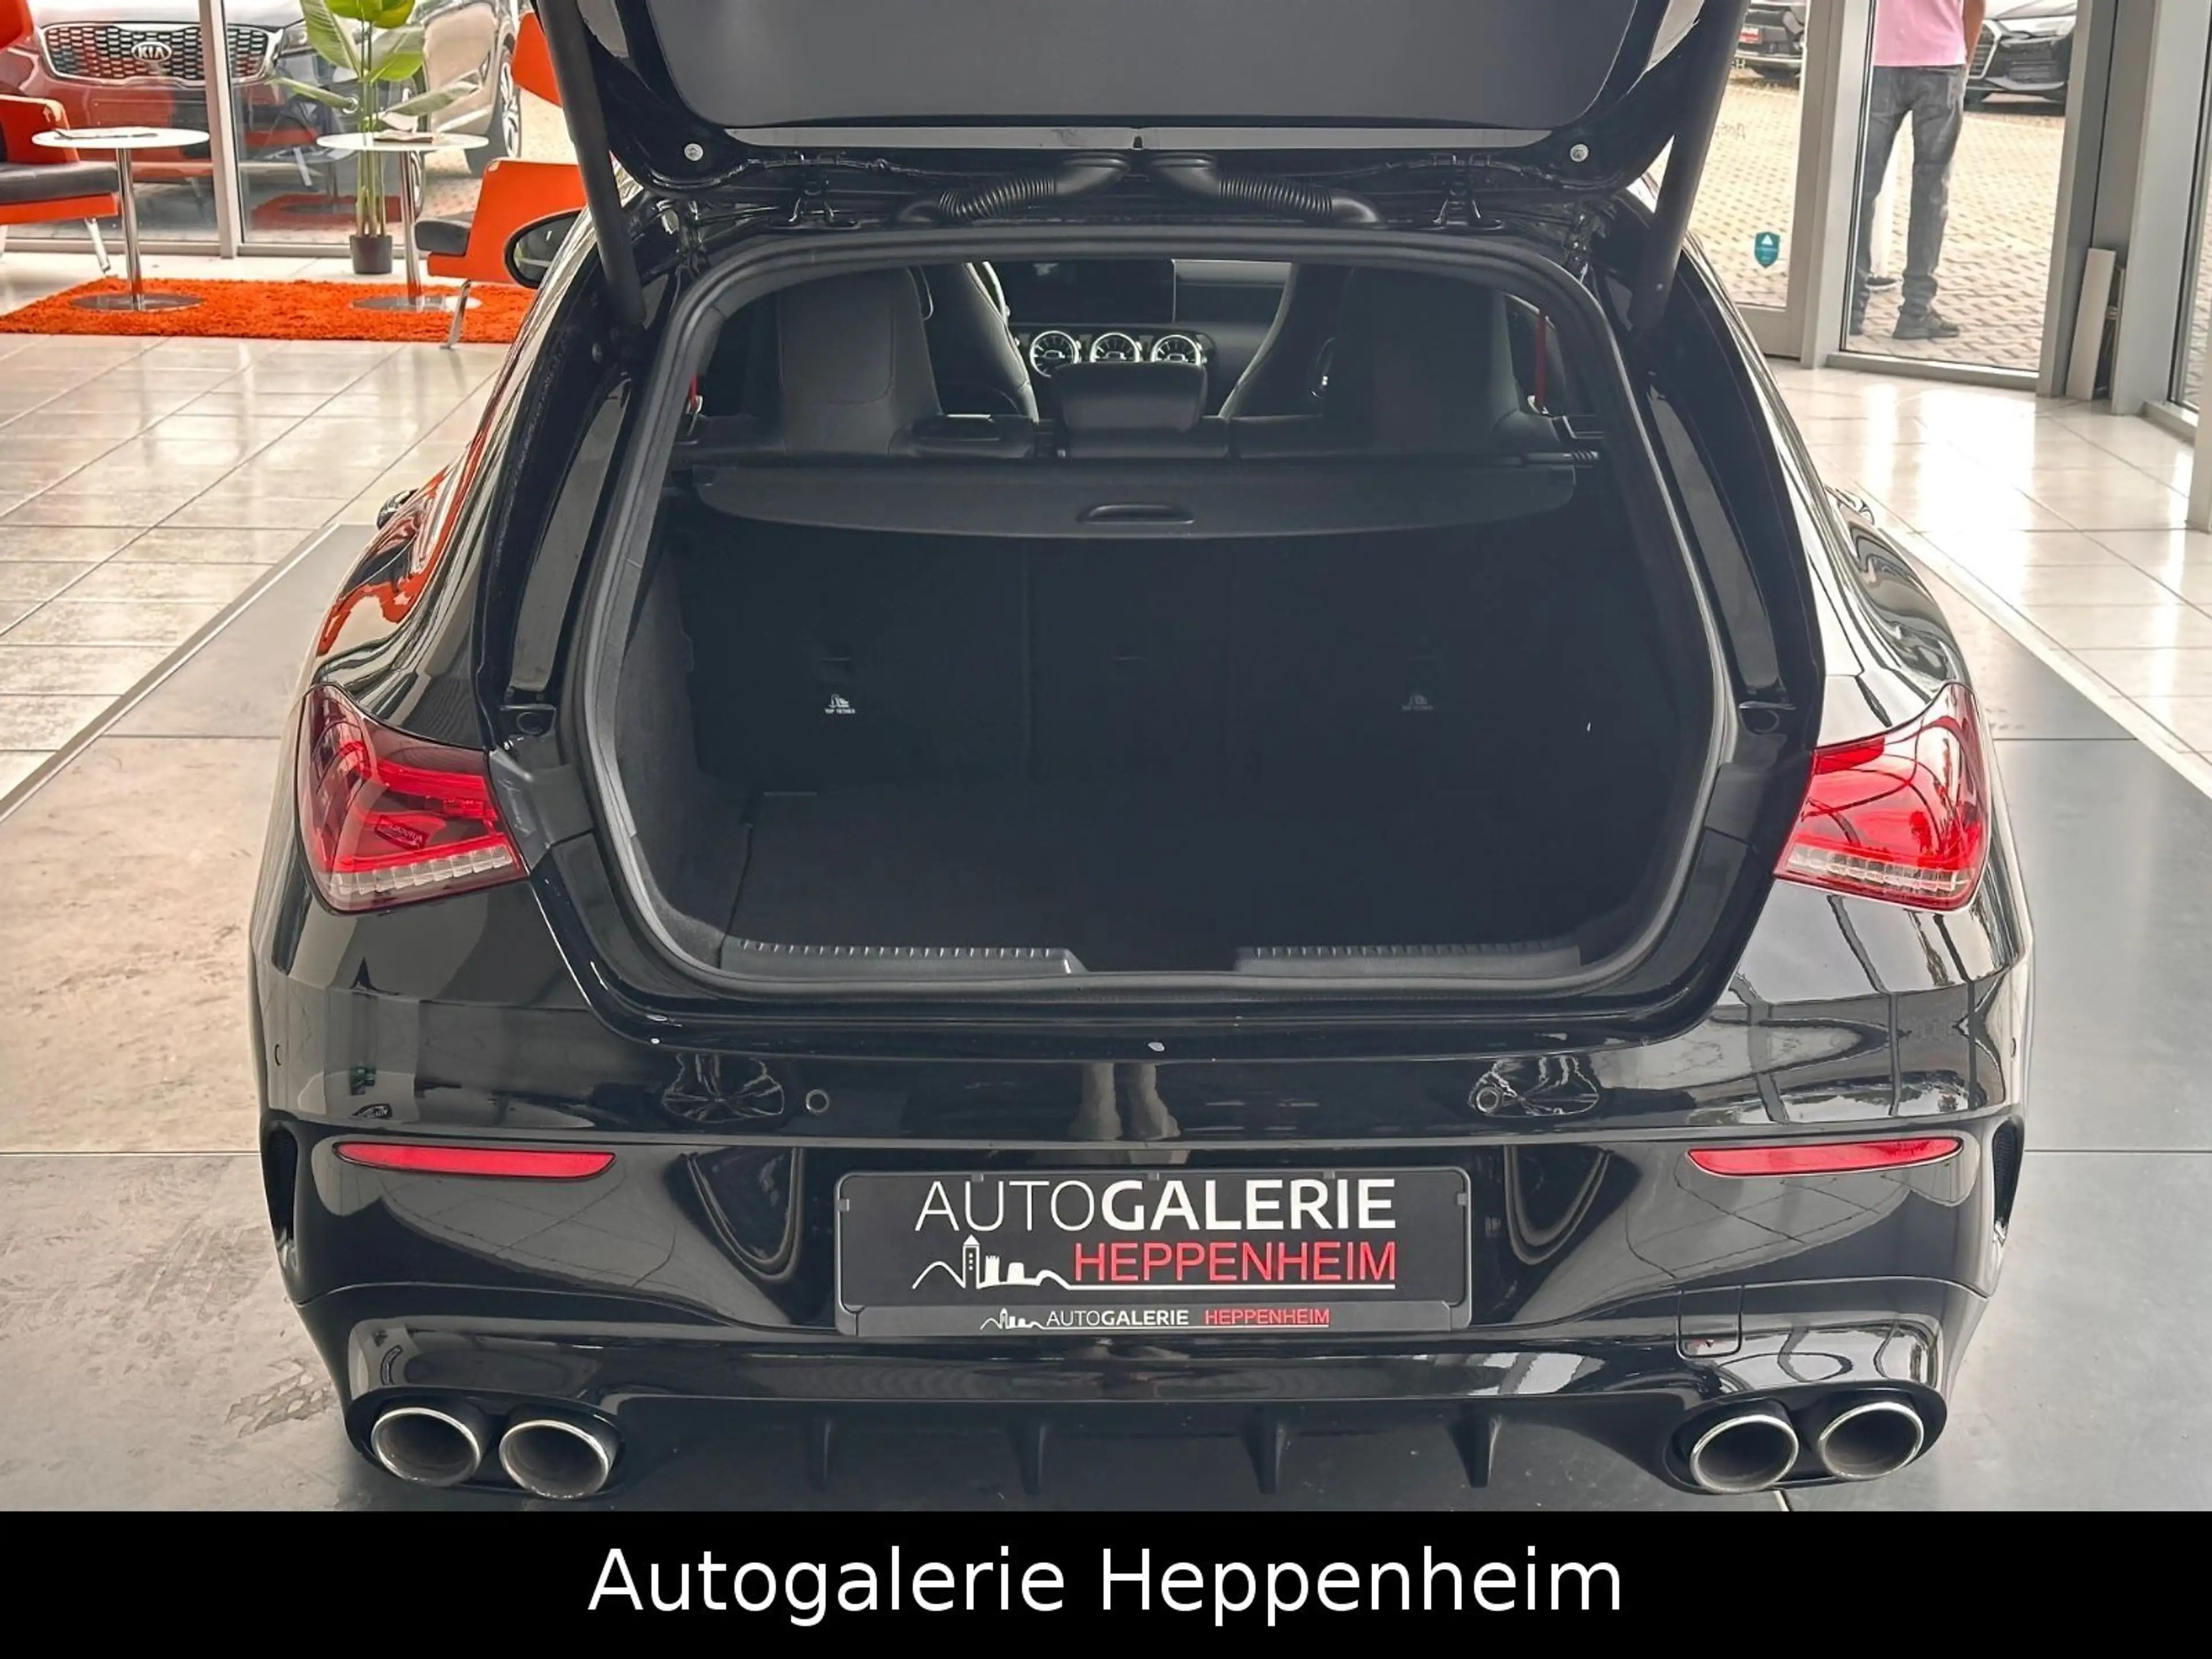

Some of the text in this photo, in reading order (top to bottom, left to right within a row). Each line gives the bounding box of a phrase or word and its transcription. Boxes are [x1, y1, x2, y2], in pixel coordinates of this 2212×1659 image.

[138, 46, 165, 58] KIA
[914, 1178, 1396, 1232] AUTOGALERIE
[1074, 1240, 1397, 1283] HEPPENHEIM
[1046, 1308, 1330, 1326] AUTOGALERIE HEPPENHEIM
